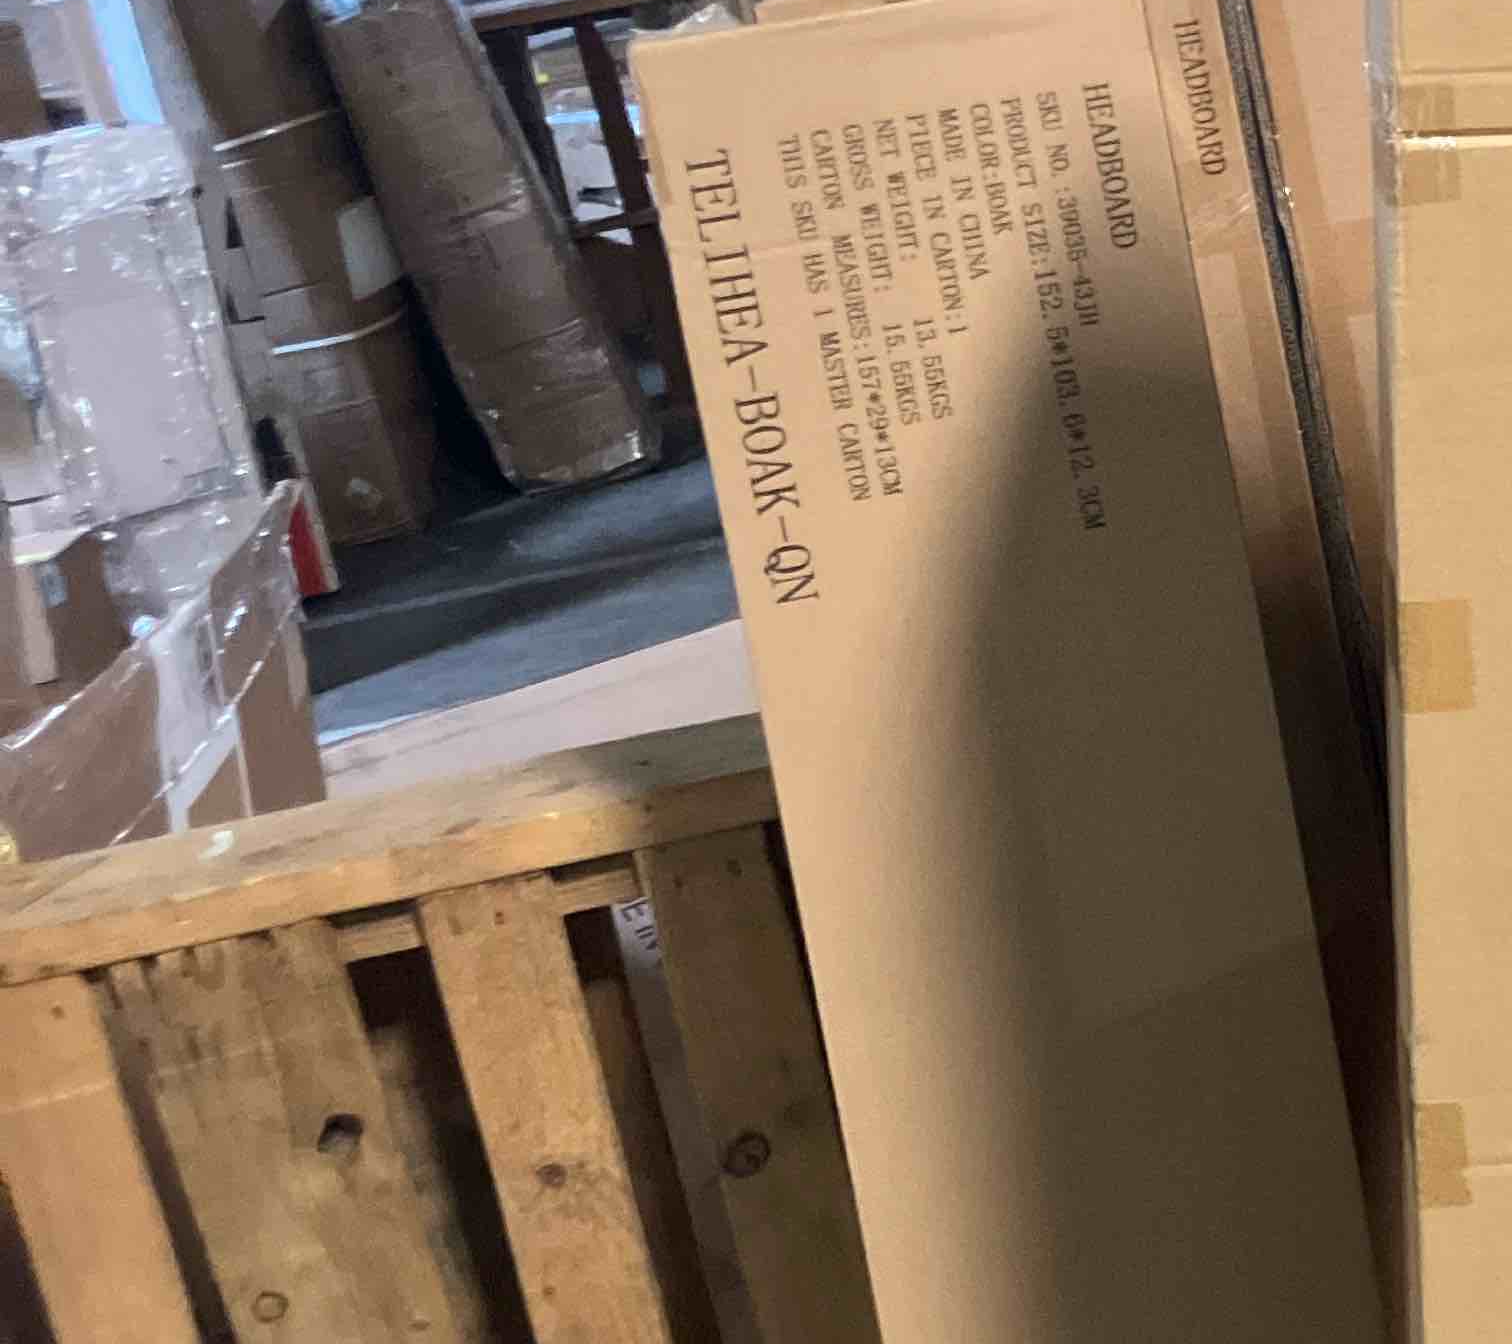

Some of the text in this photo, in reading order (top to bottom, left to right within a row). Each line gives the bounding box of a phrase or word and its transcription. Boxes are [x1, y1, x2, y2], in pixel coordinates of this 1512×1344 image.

[872, 119, 899, 158] NET
[999, 97, 1036, 189] PRODUCT
[1035, 92, 1060, 131] SKU
[1172, 19, 1227, 176] HEADBOARD
[809, 129, 844, 210] CARTON
[841, 124, 874, 191] GROSS
[859, 203, 892, 293] WEIGHT:
[885, 172, 919, 261] WEIGHT:
[904, 114, 936, 181] PIECE
[920, 195, 943, 220] IN
[937, 108, 990, 280] MADE IN CHINA
[969, 103, 1012, 236] COLOR:BOAK
[1082, 83, 1137, 249] HEADBOARD
[683, 148, 819, 606] TELIHEA-BOAK-QN
[777, 133, 871, 502] THIS SKU HAS 1 MASTER CARTON
